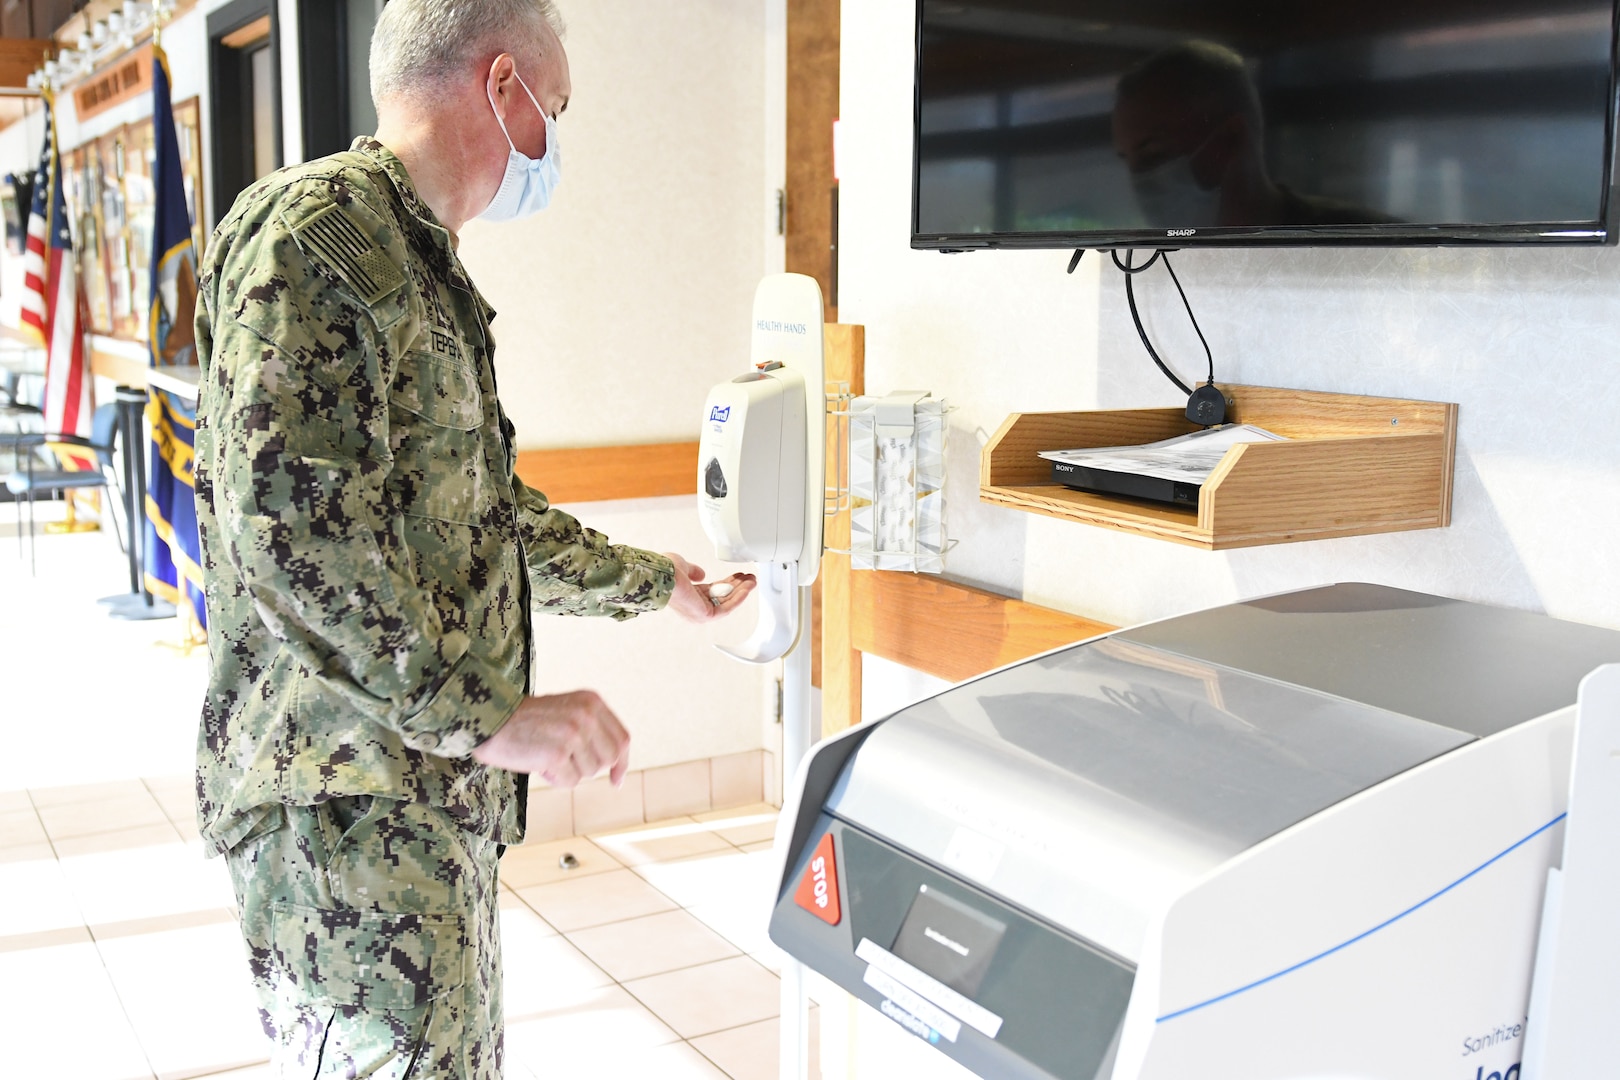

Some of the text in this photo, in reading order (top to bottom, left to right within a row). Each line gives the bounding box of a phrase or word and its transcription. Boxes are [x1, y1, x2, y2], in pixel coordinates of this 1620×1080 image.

[1167, 228, 1196, 237] SHARP
[756, 319, 806, 335] HEALTHY HANDS
[1055, 464, 1074, 473] SONY
[811, 856, 828, 909] STOP
[1462, 1023, 1521, 1057] Sanitize
